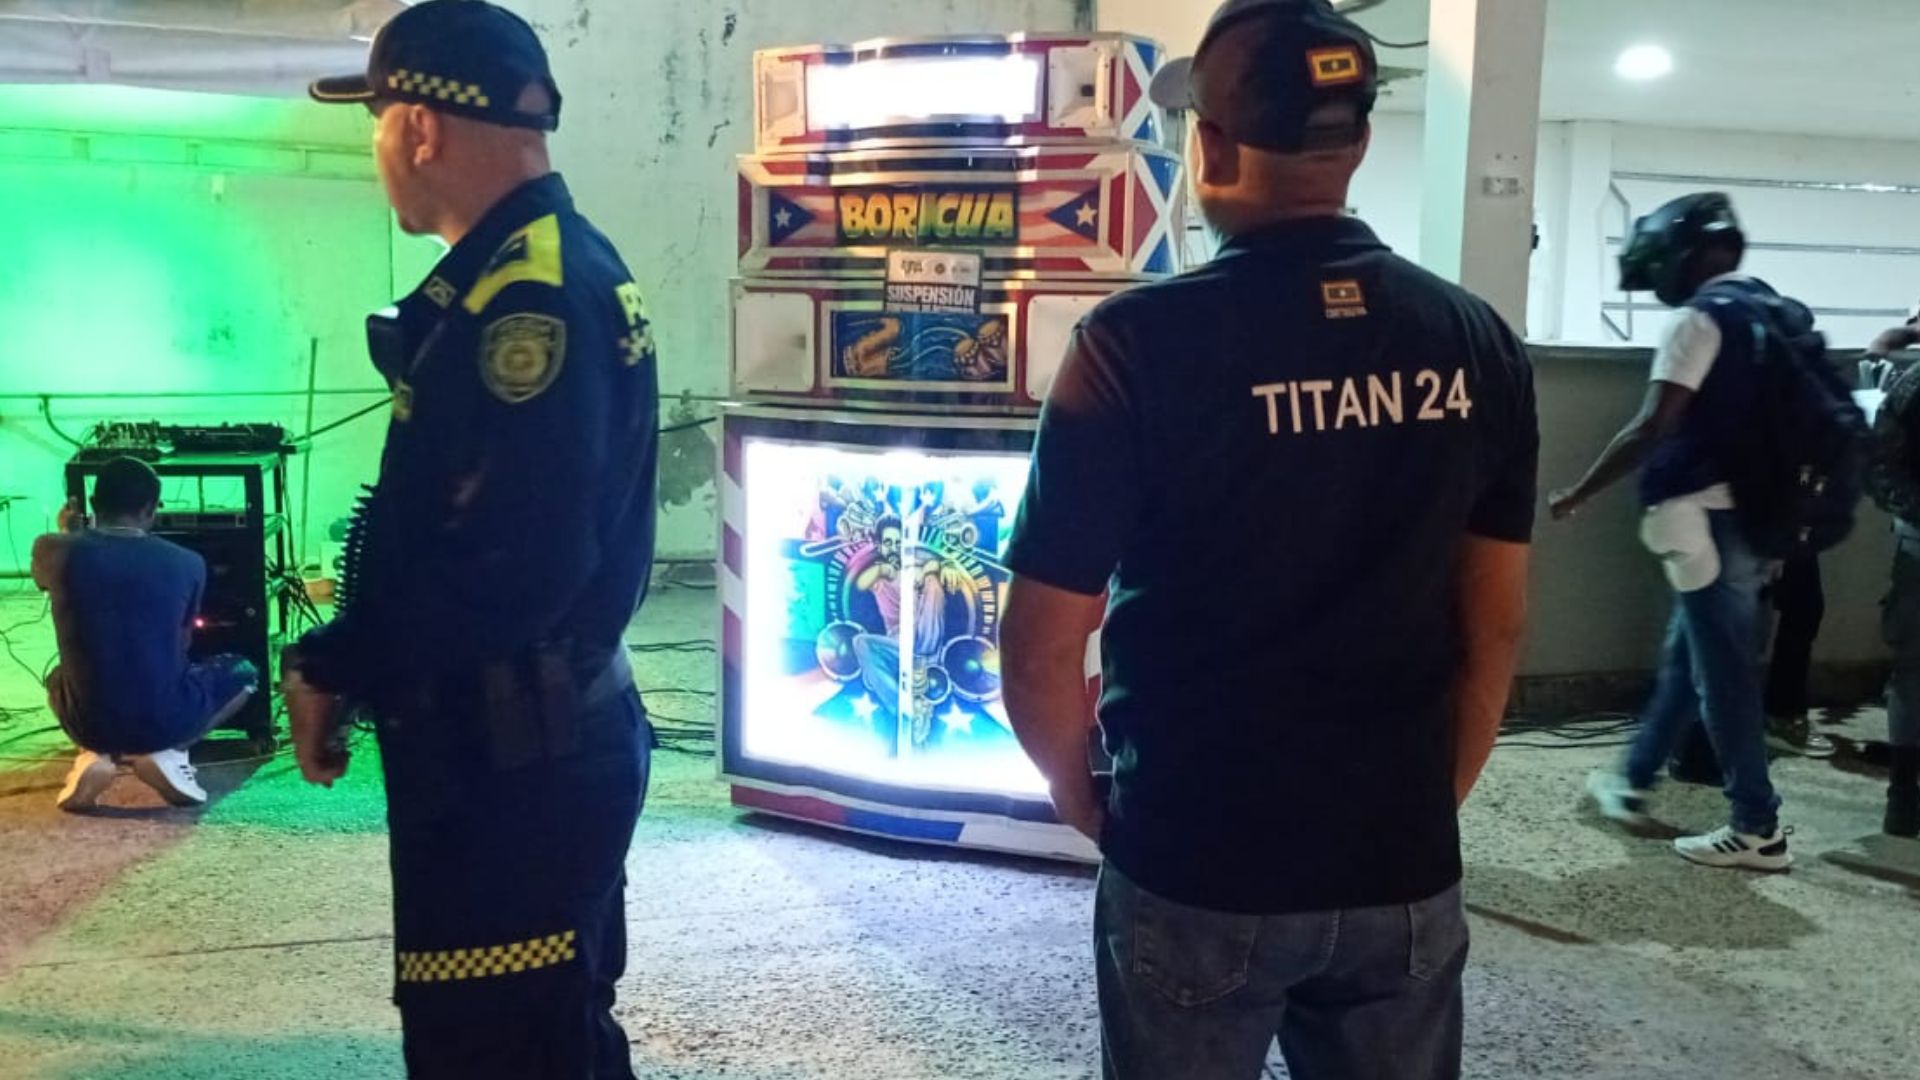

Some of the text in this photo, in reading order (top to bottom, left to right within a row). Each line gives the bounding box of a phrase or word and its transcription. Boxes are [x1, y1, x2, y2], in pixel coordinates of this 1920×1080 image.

[839, 191, 1015, 239] BORICUA
[887, 284, 975, 306] SUSPENSIÓN
[1251, 367, 1472, 434] TITAN 24
